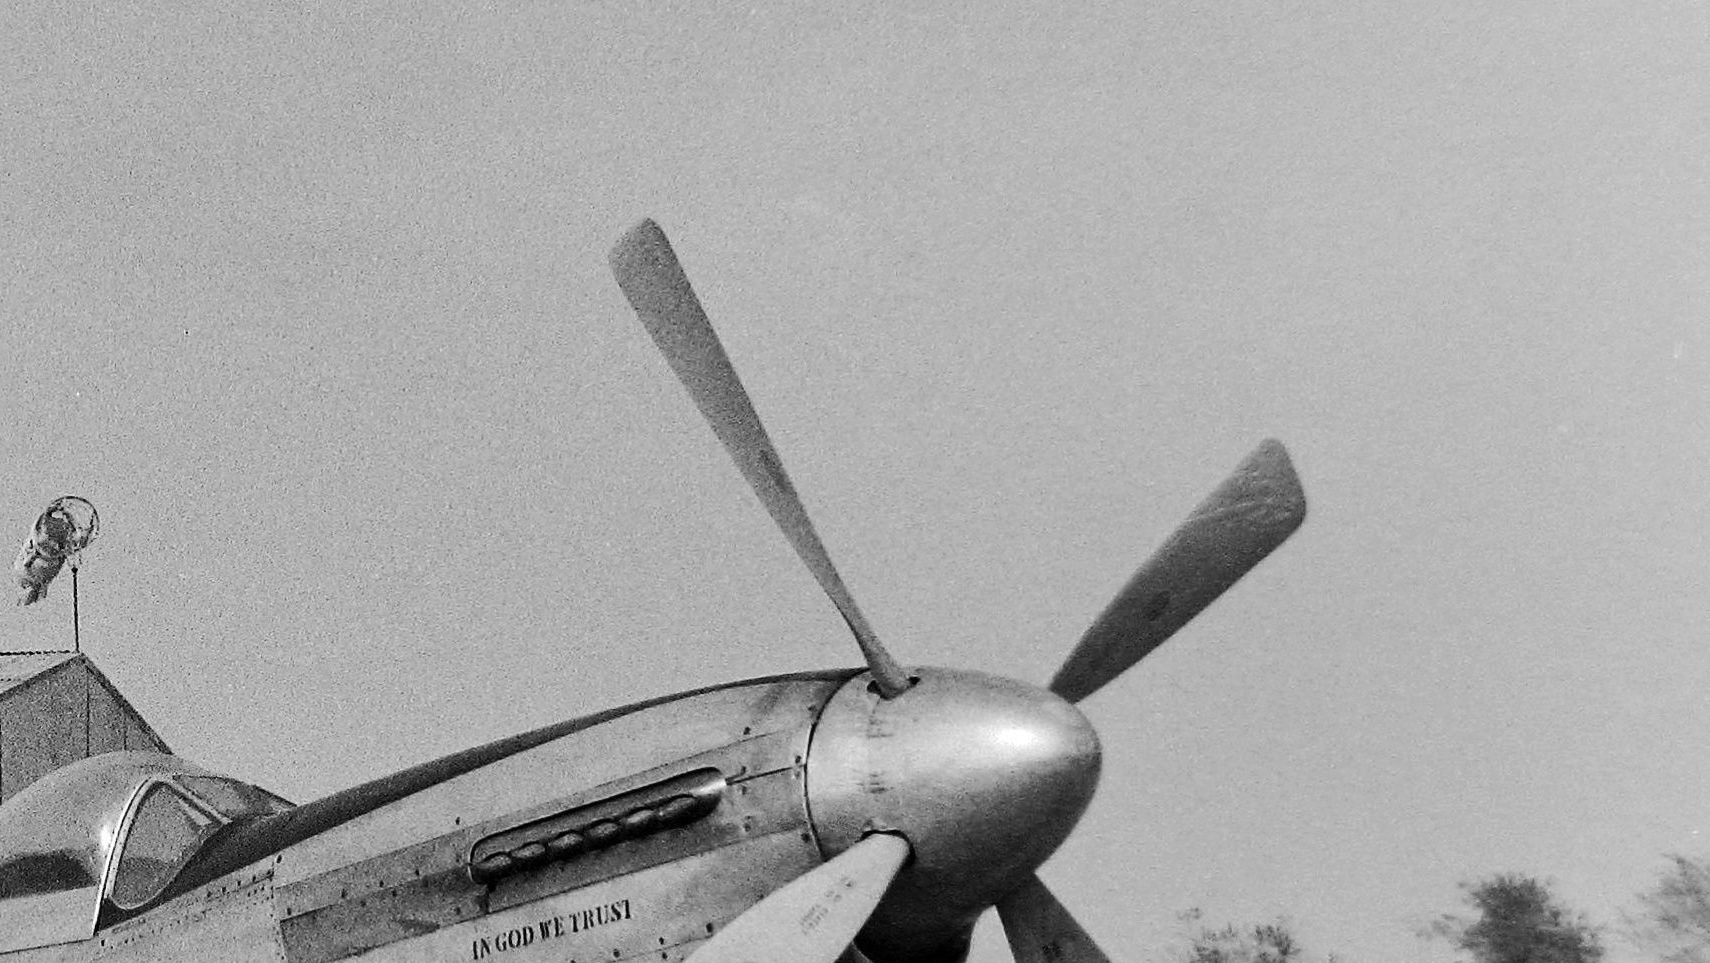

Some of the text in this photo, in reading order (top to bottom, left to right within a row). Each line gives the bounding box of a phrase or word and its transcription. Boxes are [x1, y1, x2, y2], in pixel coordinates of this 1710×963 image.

[472, 899, 631, 960] IN GOD WE TRUST
